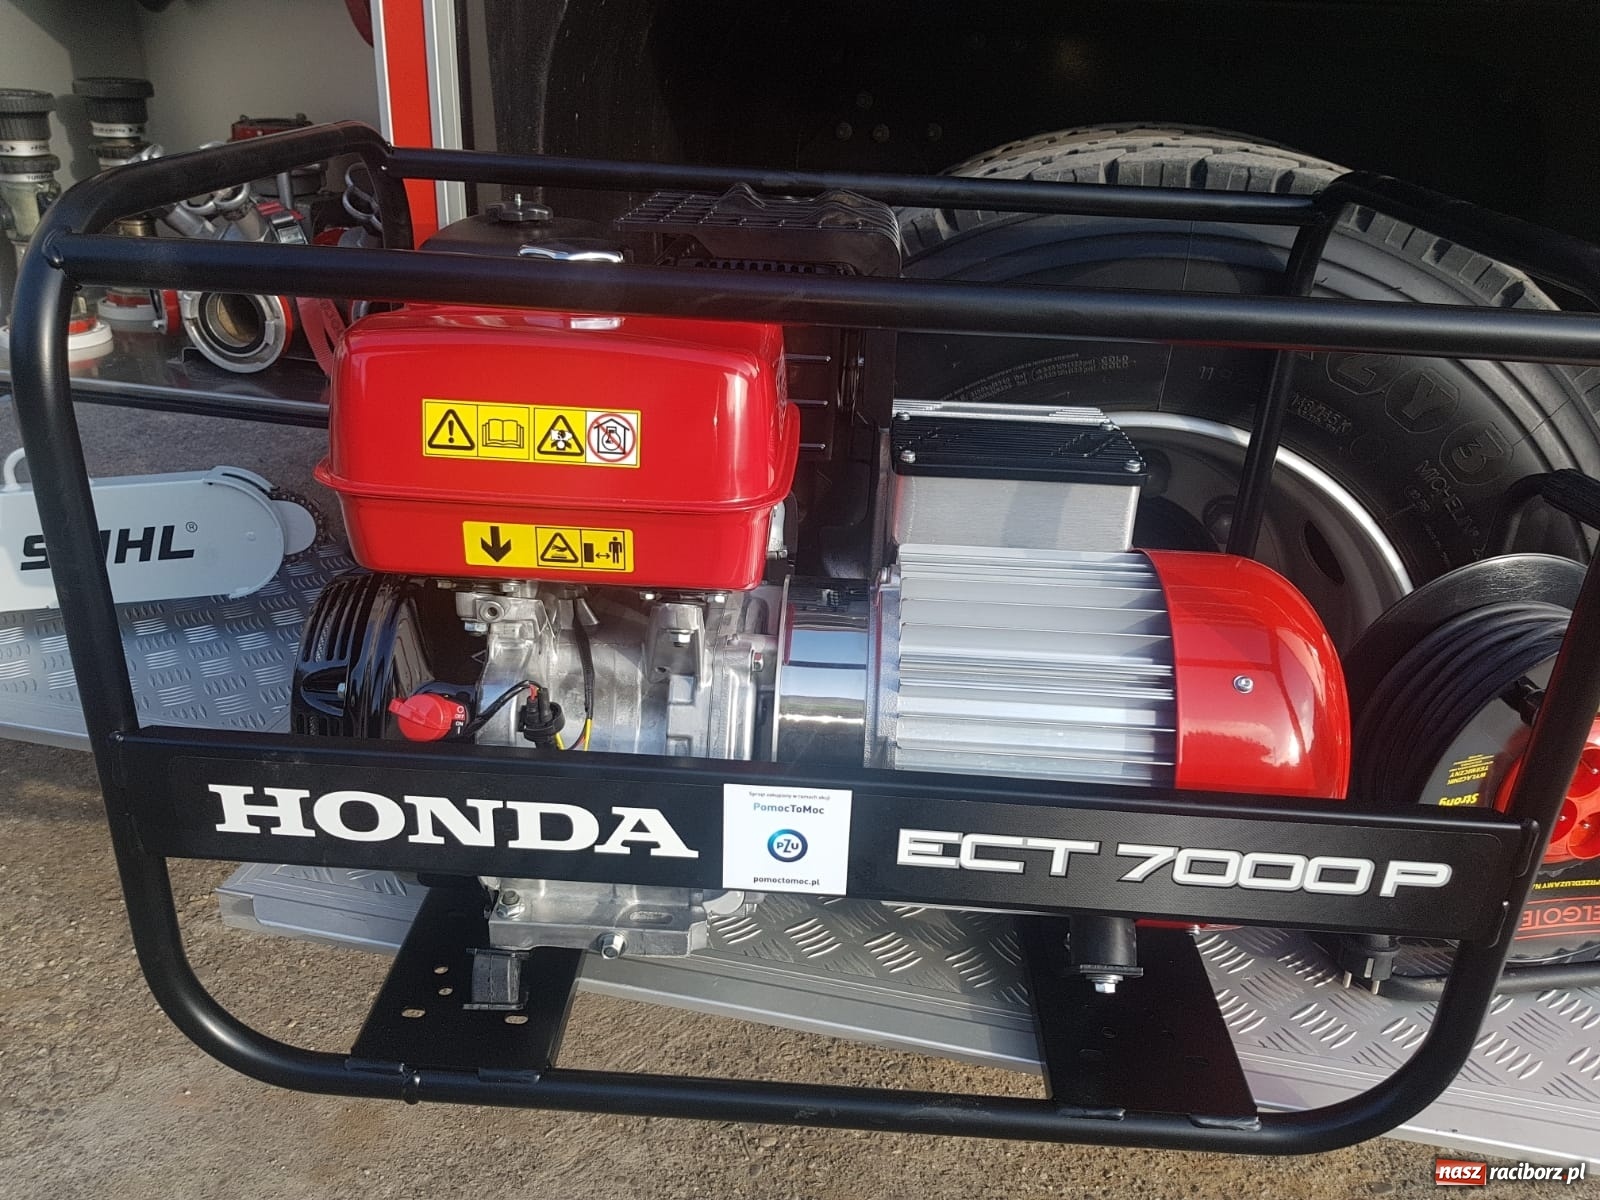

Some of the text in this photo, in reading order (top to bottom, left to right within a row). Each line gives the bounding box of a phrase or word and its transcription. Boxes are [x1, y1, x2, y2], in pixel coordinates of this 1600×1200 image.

[20, 525, 195, 571] SIHL
[208, 784, 699, 858] HONDA
[753, 802, 825, 815] PomocToMoc
[776, 838, 800, 853] PZU
[897, 828, 1101, 878] ECT
[753, 876, 820, 886] pomoctomoc.pl
